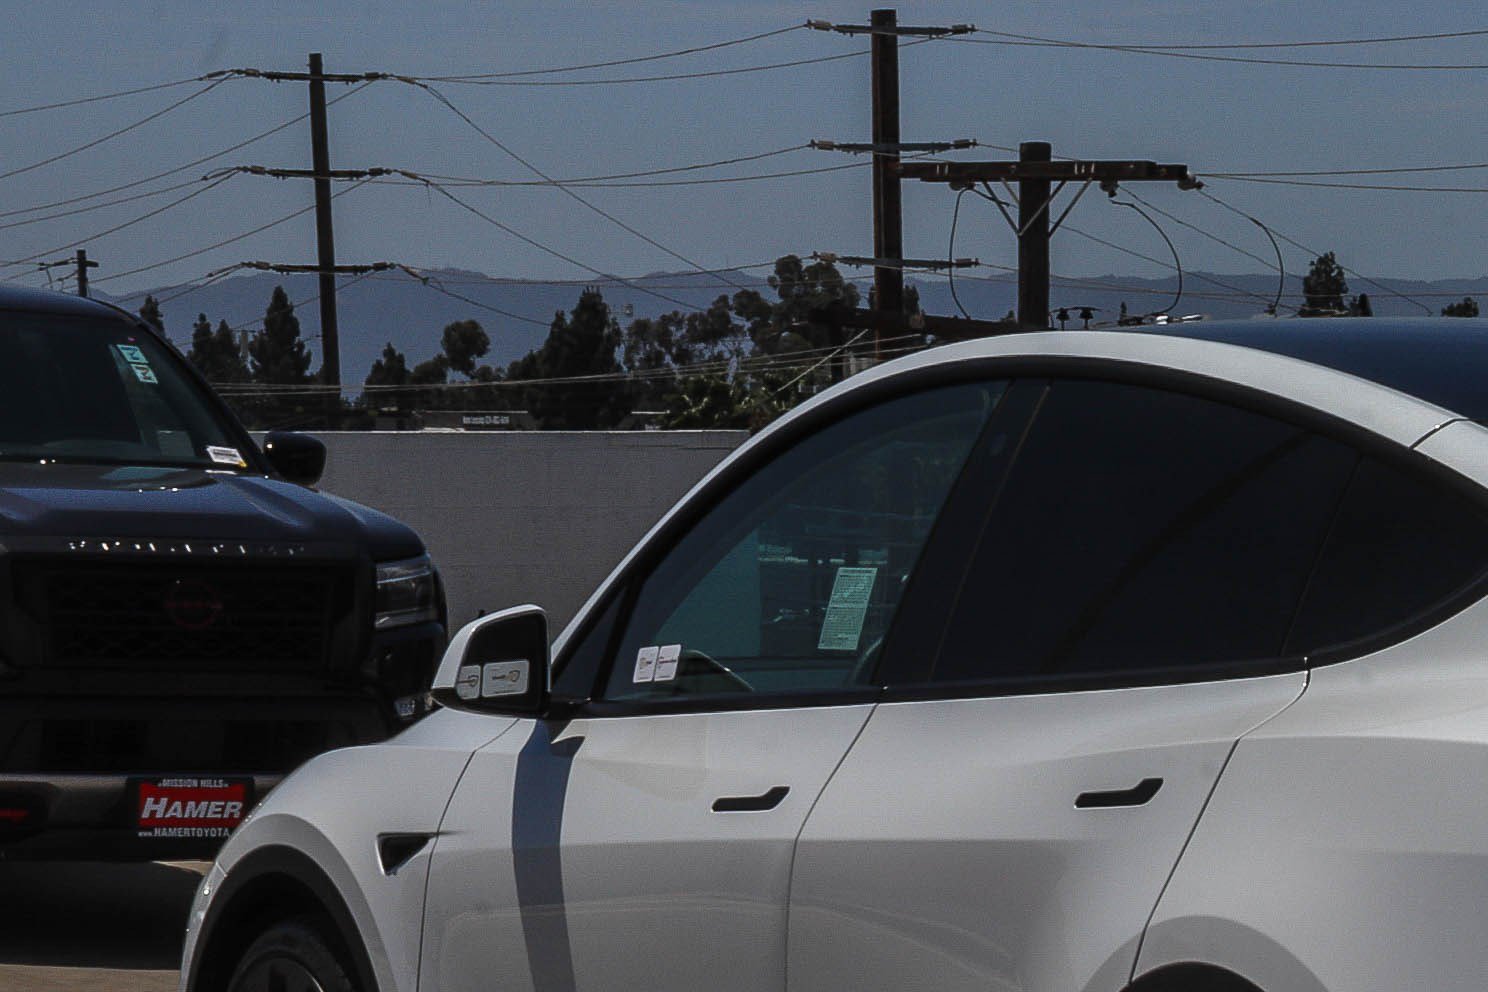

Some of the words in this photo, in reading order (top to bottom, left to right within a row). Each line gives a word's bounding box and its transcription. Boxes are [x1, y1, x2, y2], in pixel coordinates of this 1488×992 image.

[162, 778, 198, 787] MISSION
[200, 779, 224, 788] HILLS
[141, 797, 243, 818] HAMER
